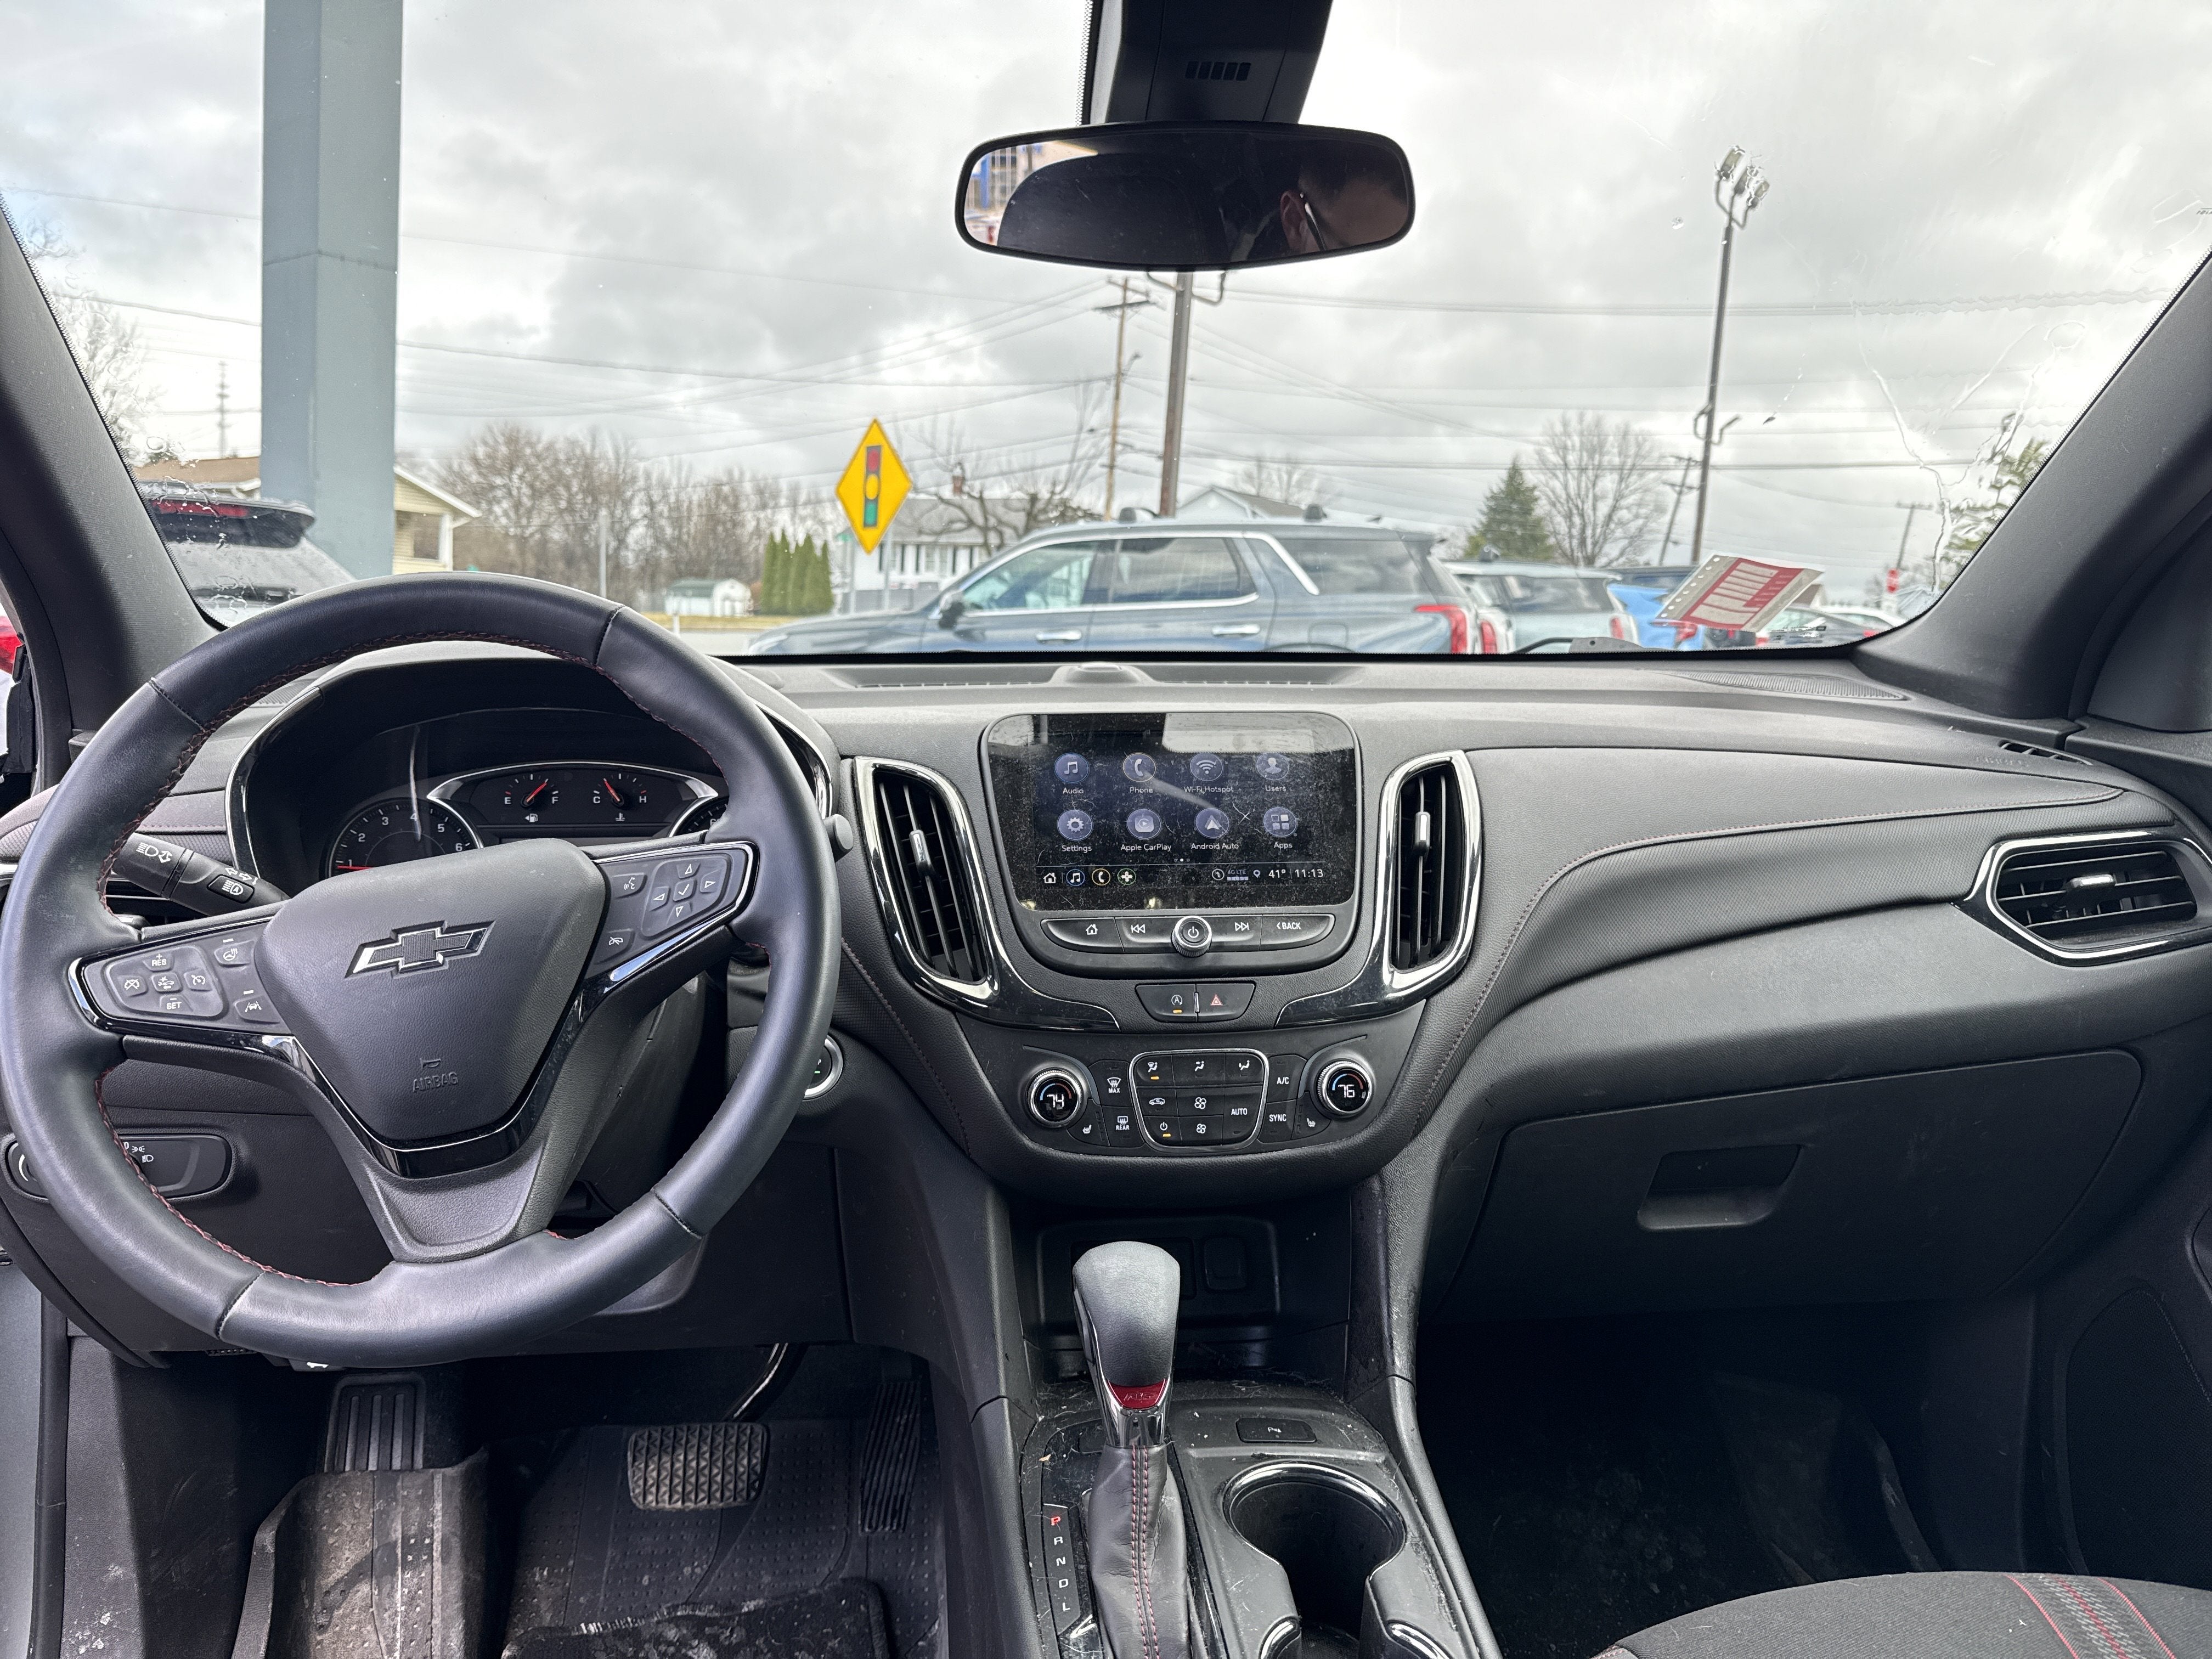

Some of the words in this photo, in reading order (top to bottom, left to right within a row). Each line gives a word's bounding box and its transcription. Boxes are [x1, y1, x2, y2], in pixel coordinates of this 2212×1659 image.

[504, 797, 511, 805] E
[551, 796, 558, 804] F
[592, 795, 601, 804] C
[639, 795, 647, 804] H
[381, 816, 389, 826] 3
[438, 823, 445, 833] 5
[358, 832, 365, 843] 2
[455, 842, 463, 851] 6
[1062, 844, 1092, 853] Settings
[1143, 843, 1172, 851] CarPlay
[1273, 841, 1293, 849] Apps
[1268, 868, 1286, 878] 41°
[1295, 868, 1324, 878] 11:13
[1282, 922, 1301, 930] BACK
[151, 958, 167, 967] RES
[166, 1001, 182, 1010] SET
[412, 1072, 459, 1093] AIRBAG
[1277, 1076, 1289, 1085] A/C
[1338, 1084, 1355, 1098] 76
[1046, 1093, 1064, 1108] 74
[1269, 1114, 1287, 1122] SYNC
[1051, 1516, 1061, 1526] P
[1053, 1536, 1063, 1545] R
[1056, 1556, 1066, 1566] N
[1058, 1578, 1069, 1588] D
[1062, 1602, 1071, 1611] L
